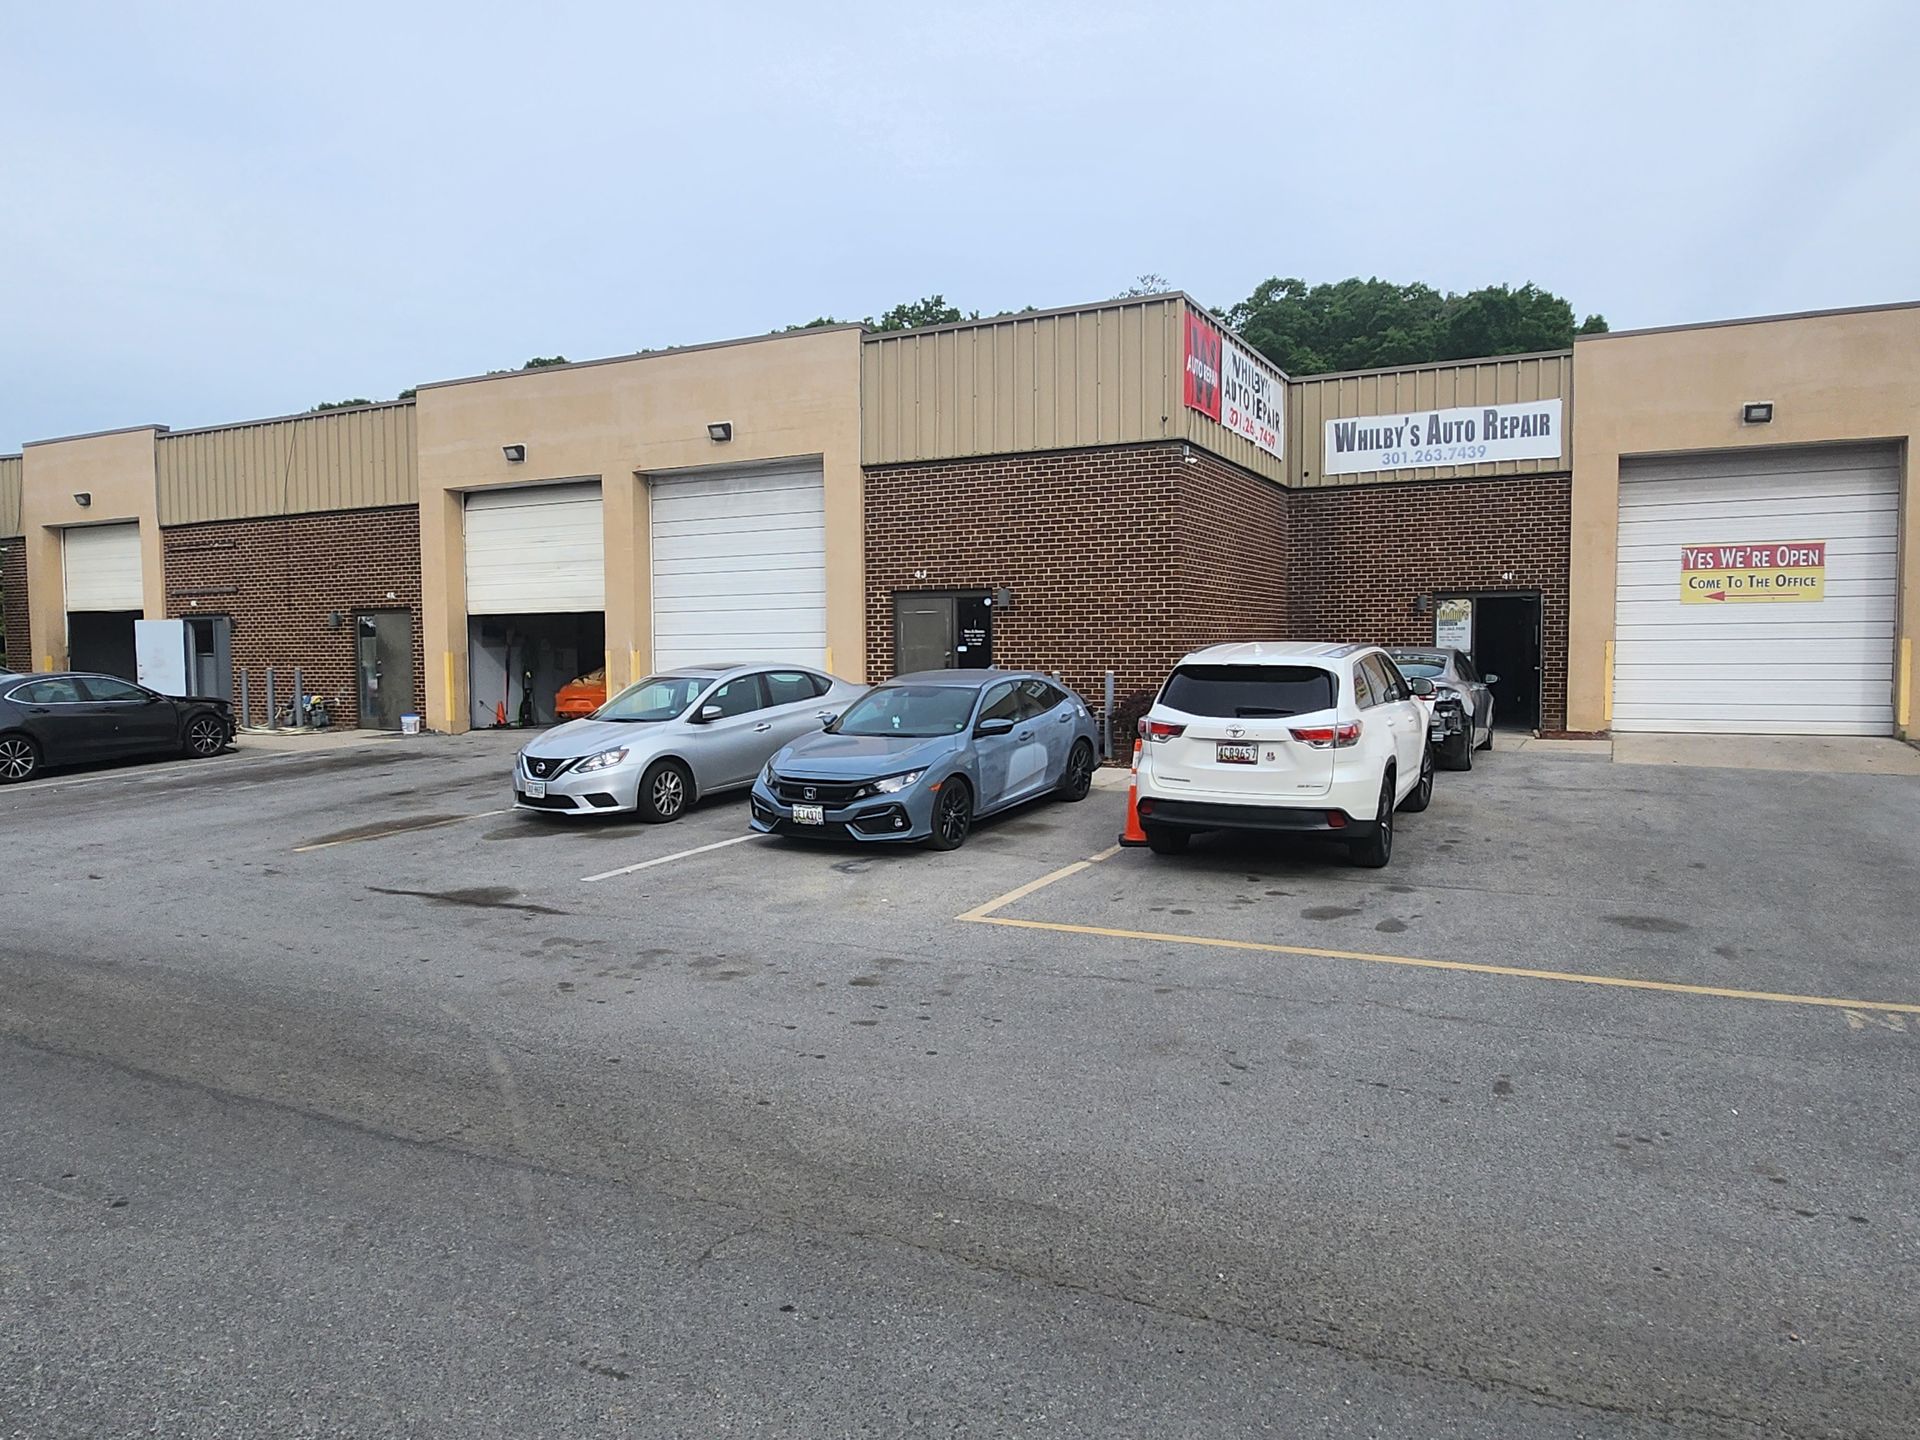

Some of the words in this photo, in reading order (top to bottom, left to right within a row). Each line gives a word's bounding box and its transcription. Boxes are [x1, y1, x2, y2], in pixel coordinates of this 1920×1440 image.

[1186, 354, 1203, 378] AUTO
[1224, 376, 1250, 409] AUTO
[1334, 416, 1420, 453] WHILBY'S
[1426, 414, 1476, 446] AUTO
[1483, 409, 1551, 441] REPAIR
[1382, 445, 1487, 465] 301.263.7439
[1687, 549, 1714, 568] YES
[1720, 548, 1771, 568] WE'RE
[1776, 546, 1819, 566] OPEN
[1689, 576, 1721, 588] COME
[1727, 575, 1743, 588] TO
[1748, 575, 1770, 588] THE
[1775, 574, 1817, 587] OFFICE
